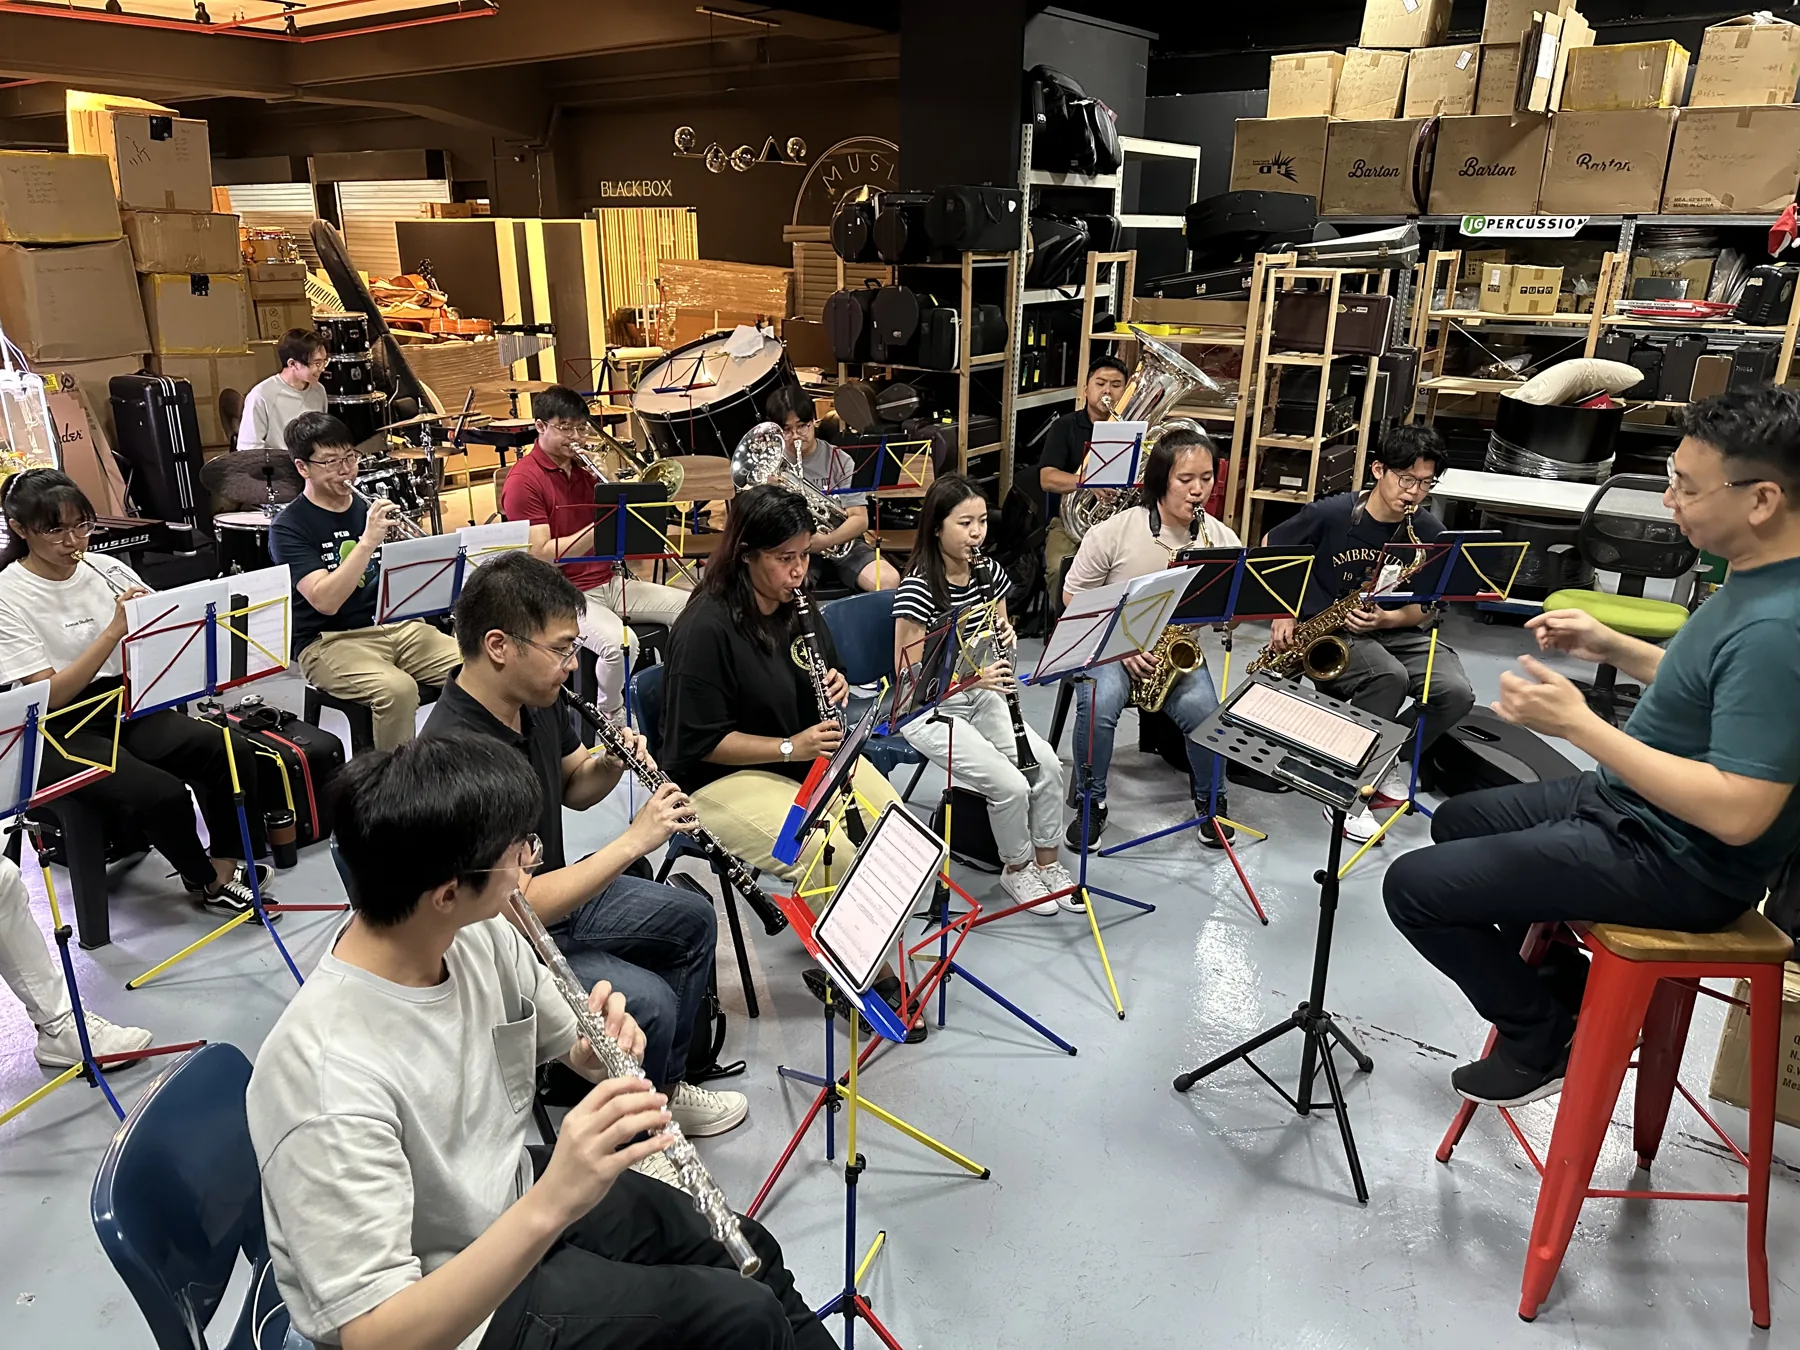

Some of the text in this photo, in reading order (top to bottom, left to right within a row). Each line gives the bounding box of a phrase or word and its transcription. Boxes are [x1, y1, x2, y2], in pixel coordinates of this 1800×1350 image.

[1348, 158, 1401, 179] Barton
[1458, 156, 1517, 177] Barton
[600, 179, 673, 197] BLACK BOX
[1467, 218, 1484, 231] JG
